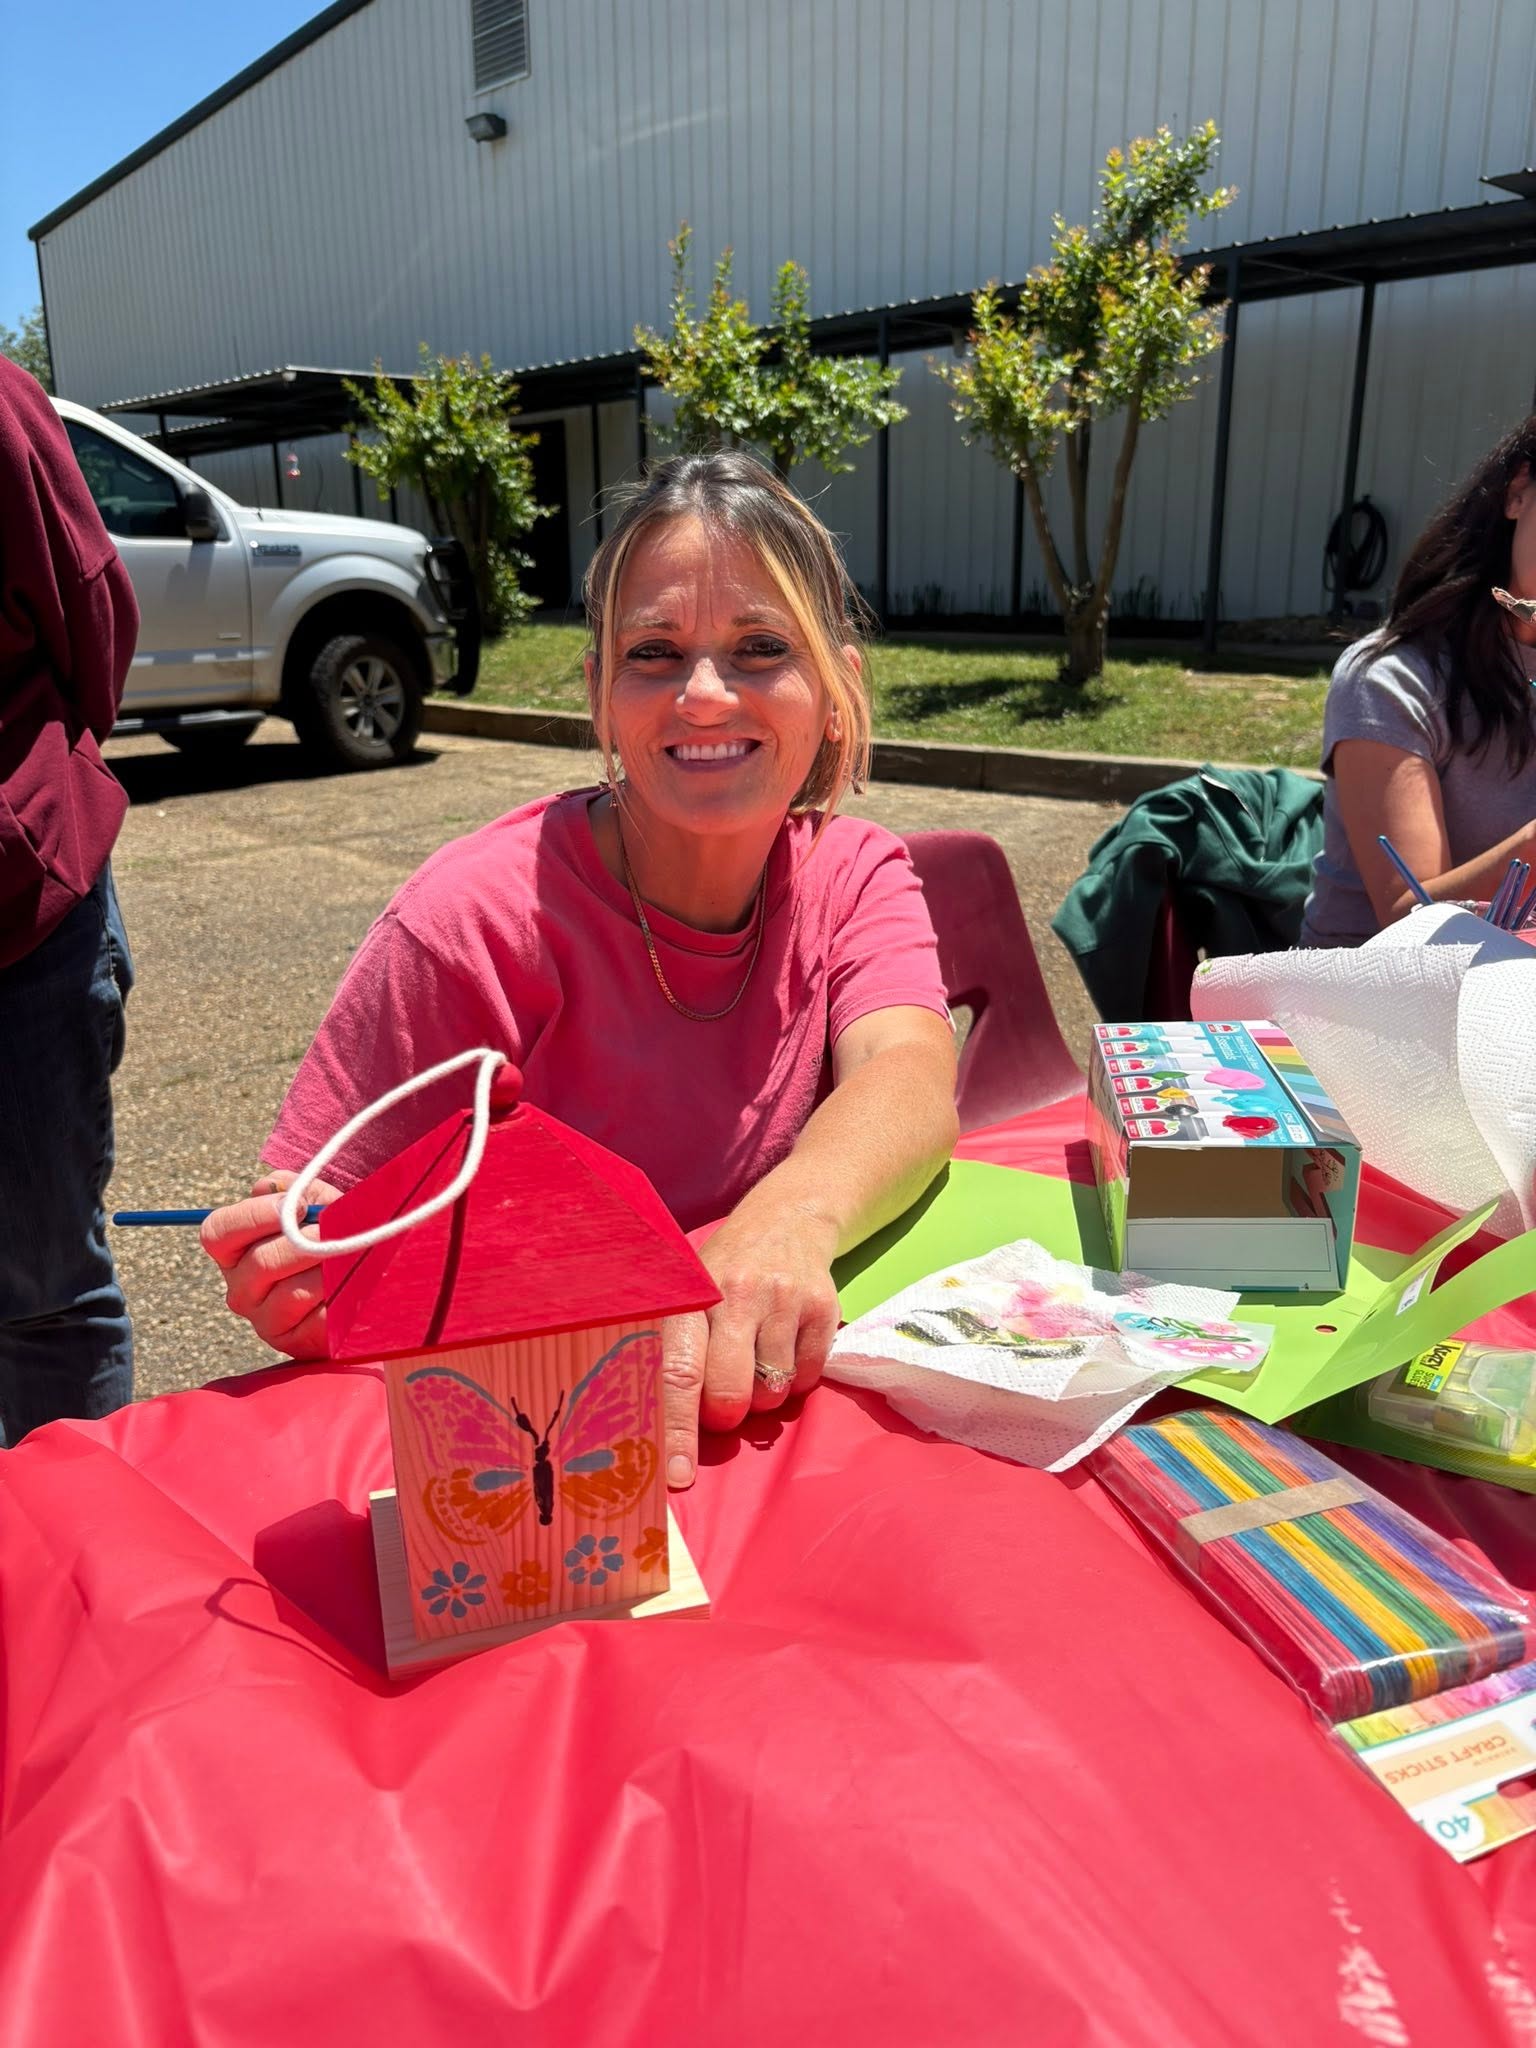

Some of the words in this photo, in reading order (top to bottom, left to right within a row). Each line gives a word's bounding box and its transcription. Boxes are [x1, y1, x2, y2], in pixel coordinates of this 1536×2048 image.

[1450, 1735, 1507, 1762] CRAFT
[1383, 1755, 1448, 1784] STICKS
[1437, 1816, 1470, 1839] 40
